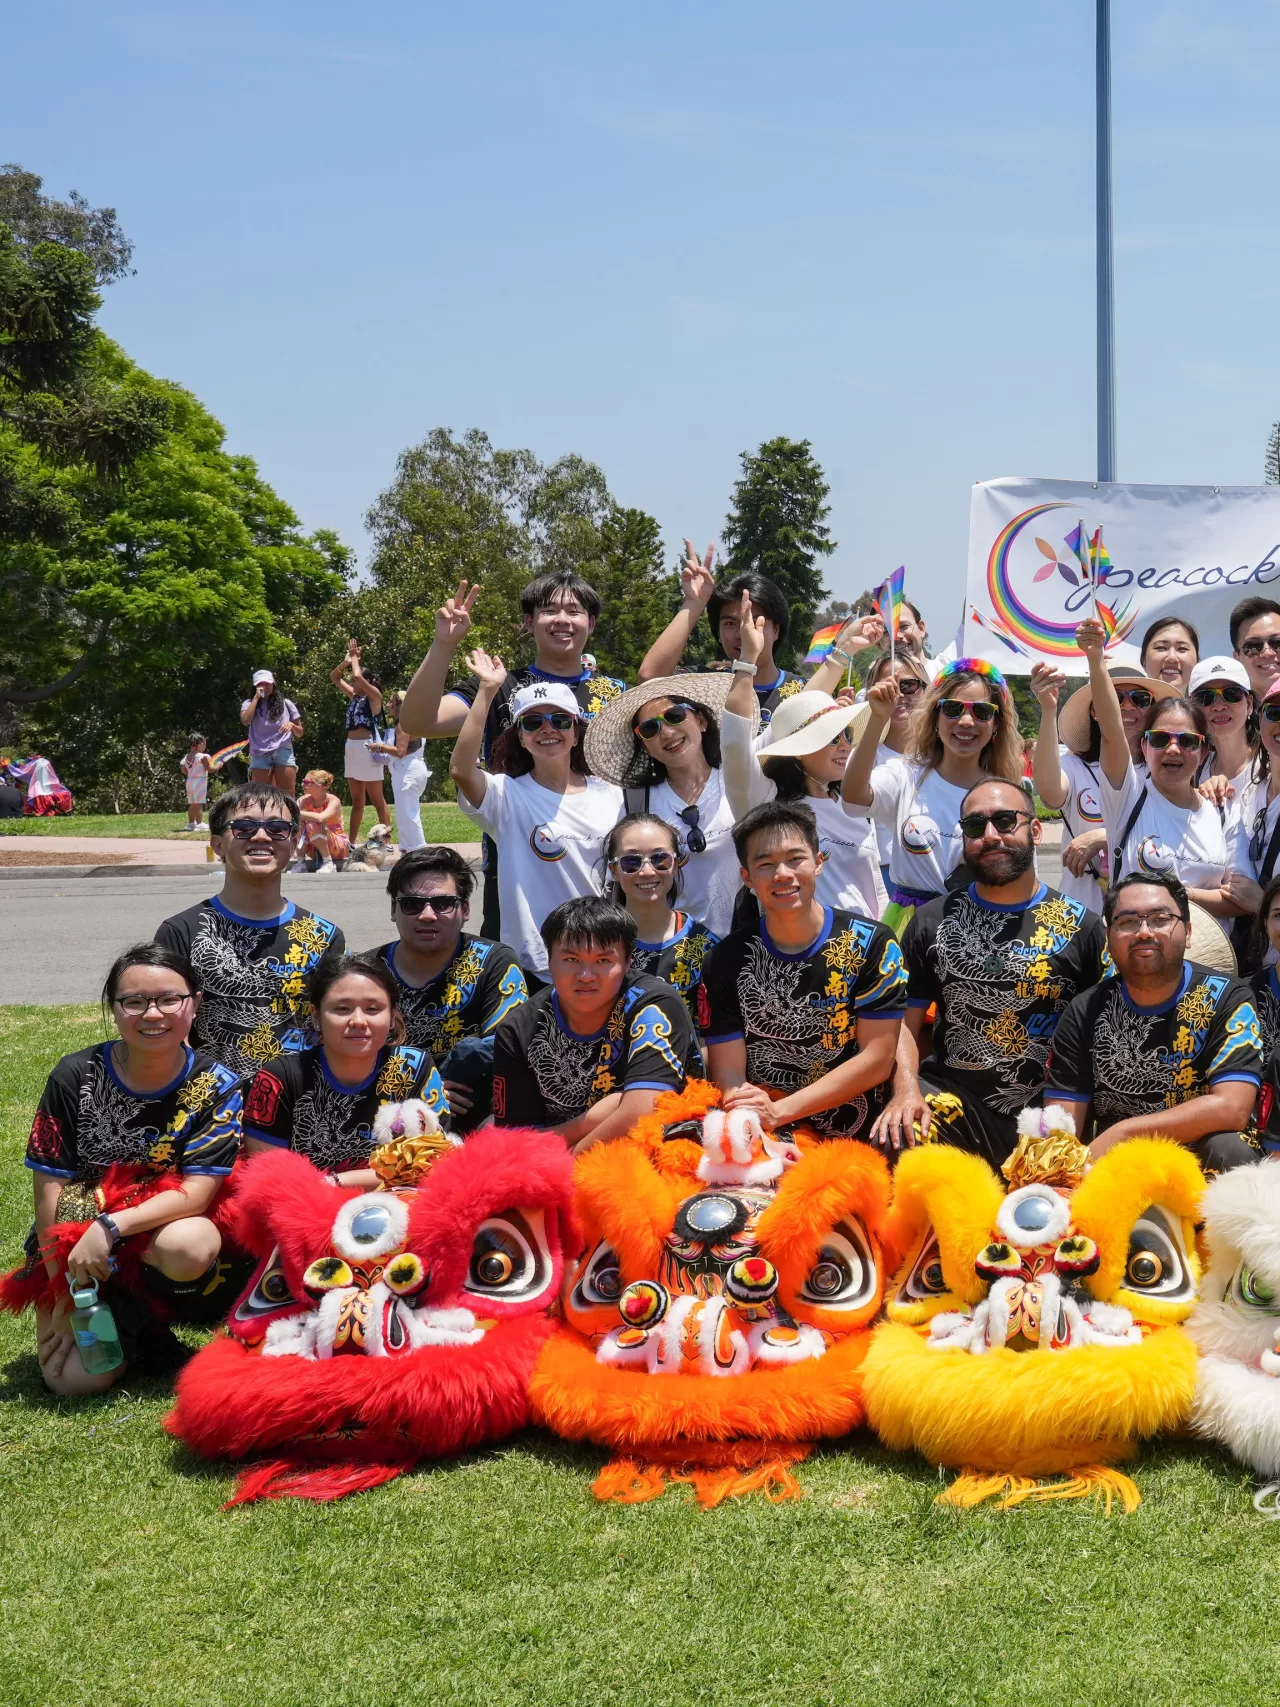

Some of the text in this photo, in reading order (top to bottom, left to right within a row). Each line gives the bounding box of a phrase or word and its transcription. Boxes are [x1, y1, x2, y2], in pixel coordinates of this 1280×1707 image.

[533, 687, 548, 699] NY
[819, 838, 857, 848] peacock
[1163, 852, 1204, 863] peacock
[281, 943, 308, 997] 南海
[1026, 926, 1054, 982] 南海
[441, 983, 465, 1036] 南海
[824, 971, 850, 1032] 南海
[1172, 1026, 1199, 1089] 南海
